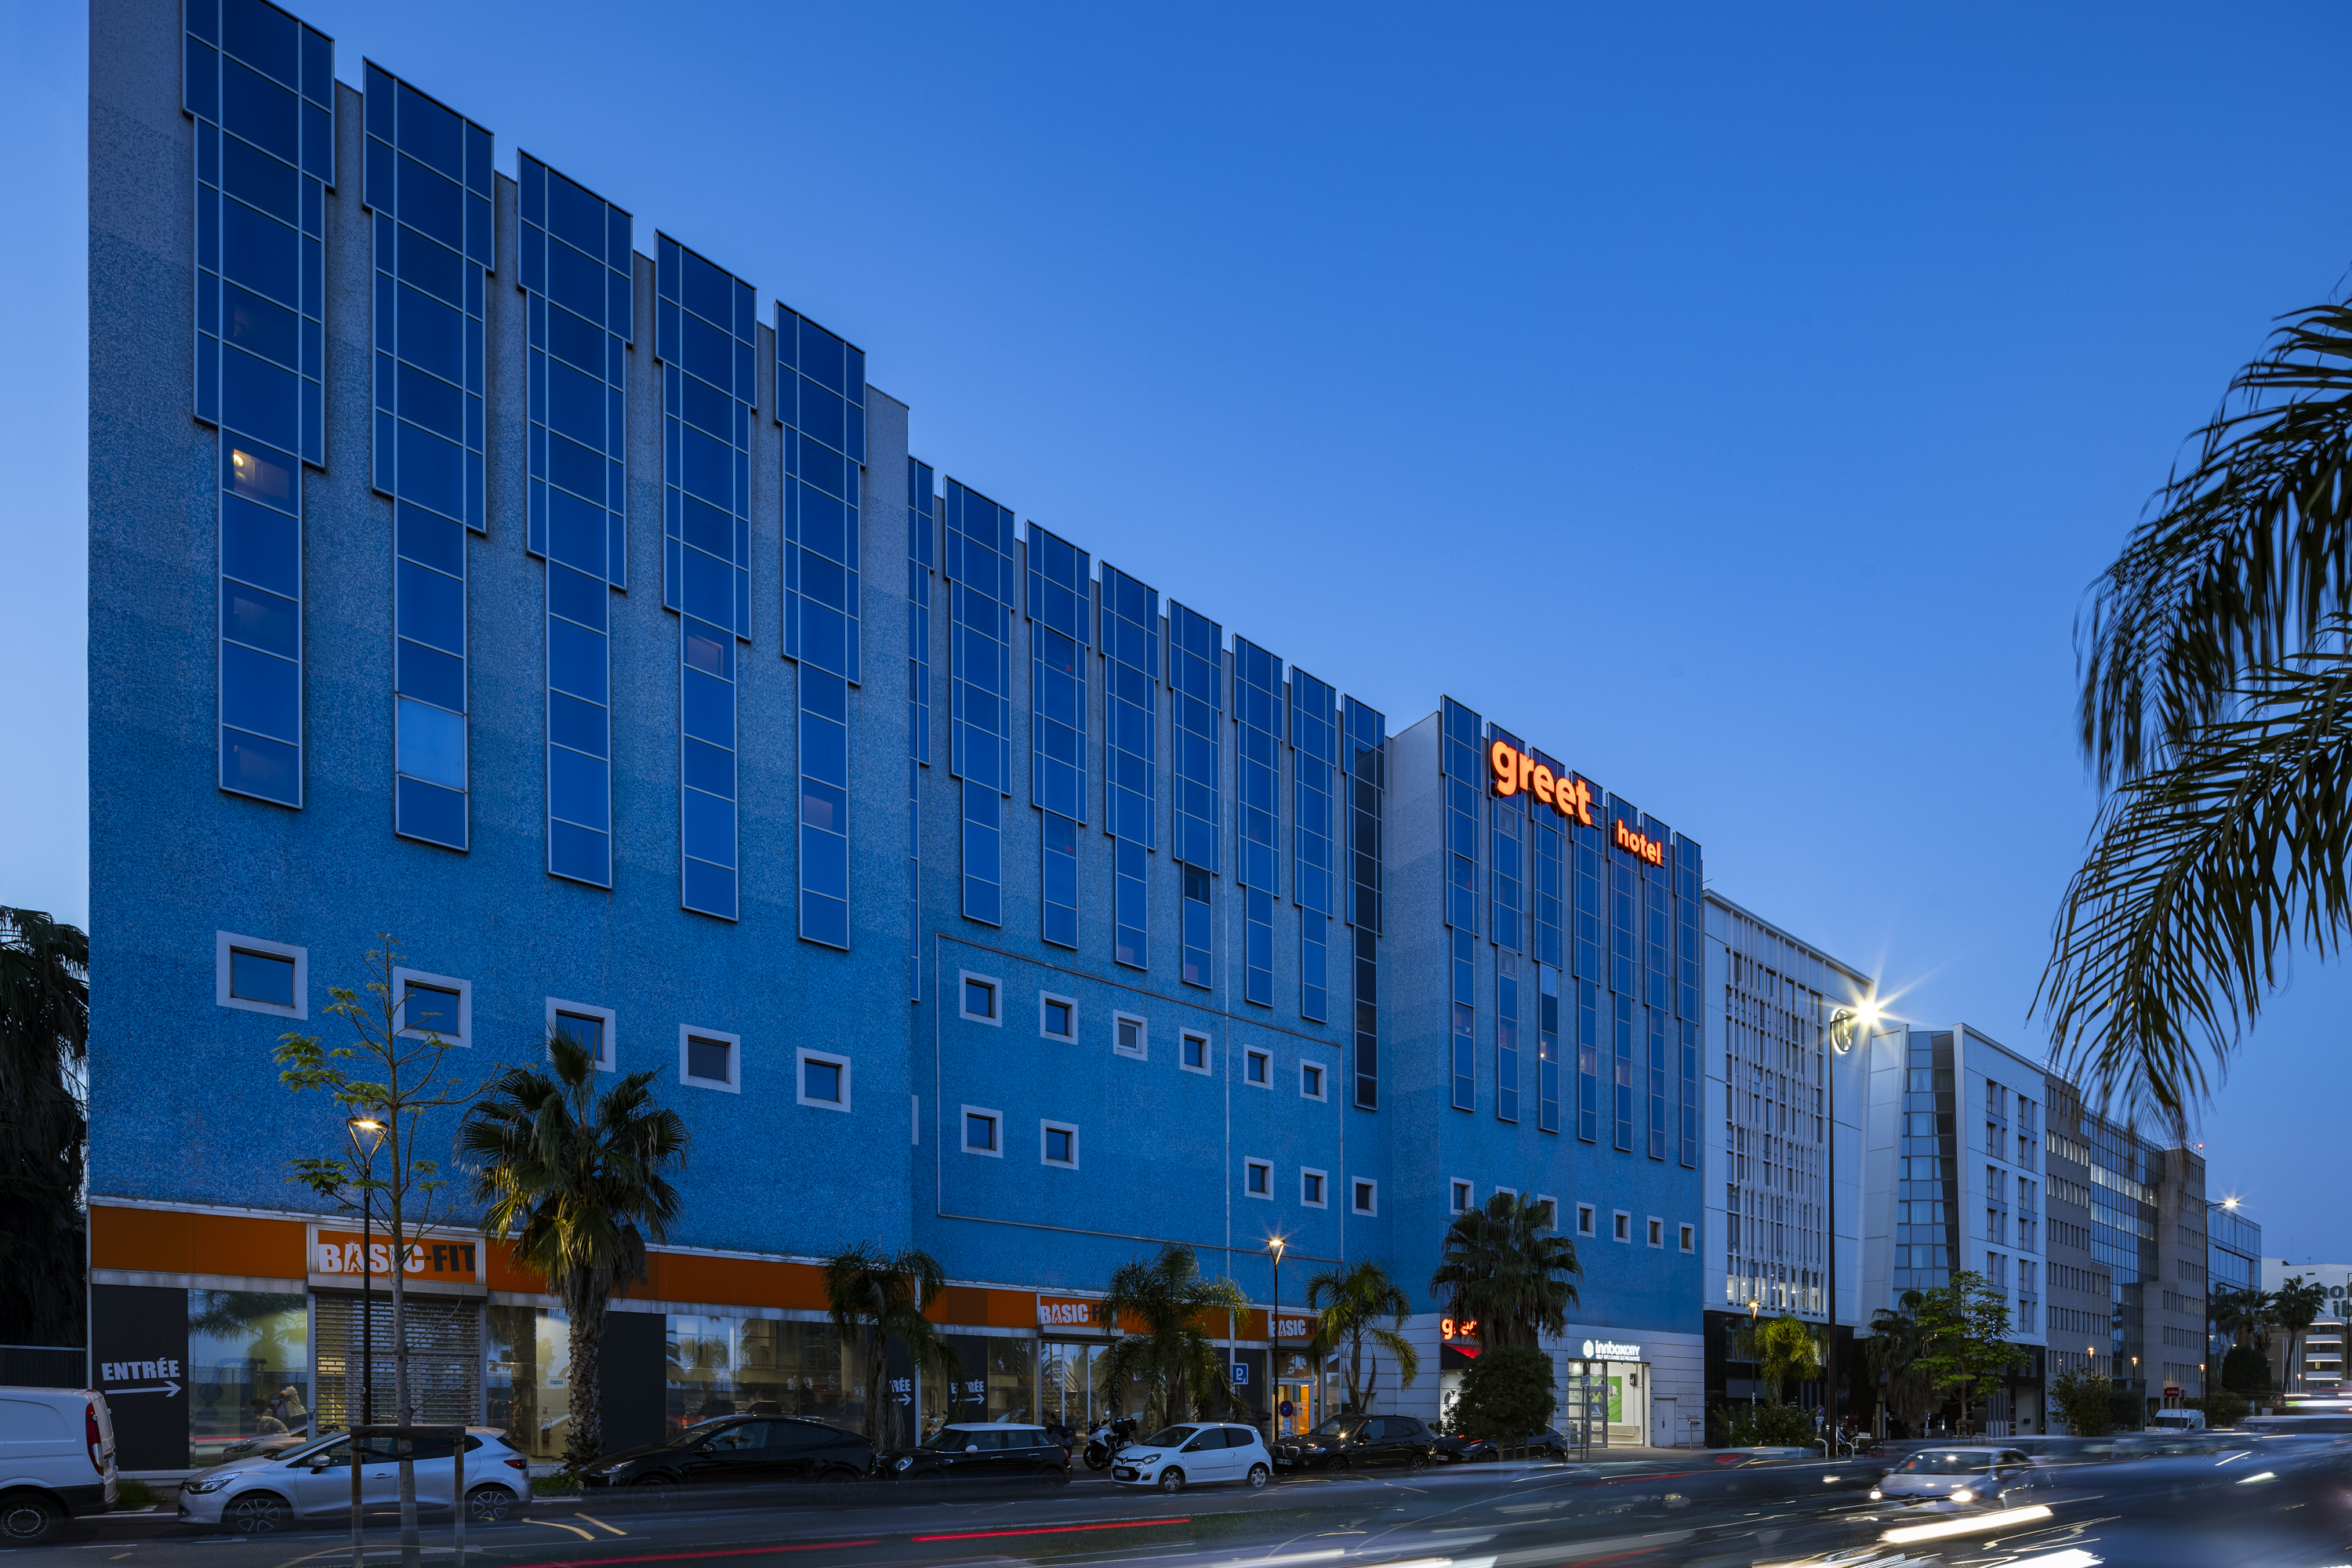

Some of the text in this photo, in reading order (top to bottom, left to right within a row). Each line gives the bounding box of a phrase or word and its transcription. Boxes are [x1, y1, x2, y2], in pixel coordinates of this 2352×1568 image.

[1491, 740, 1661, 866] greet hotel
[1270, 1319, 1318, 1338] BASIC-FI
[101, 1357, 181, 1381] ENTRÉE
